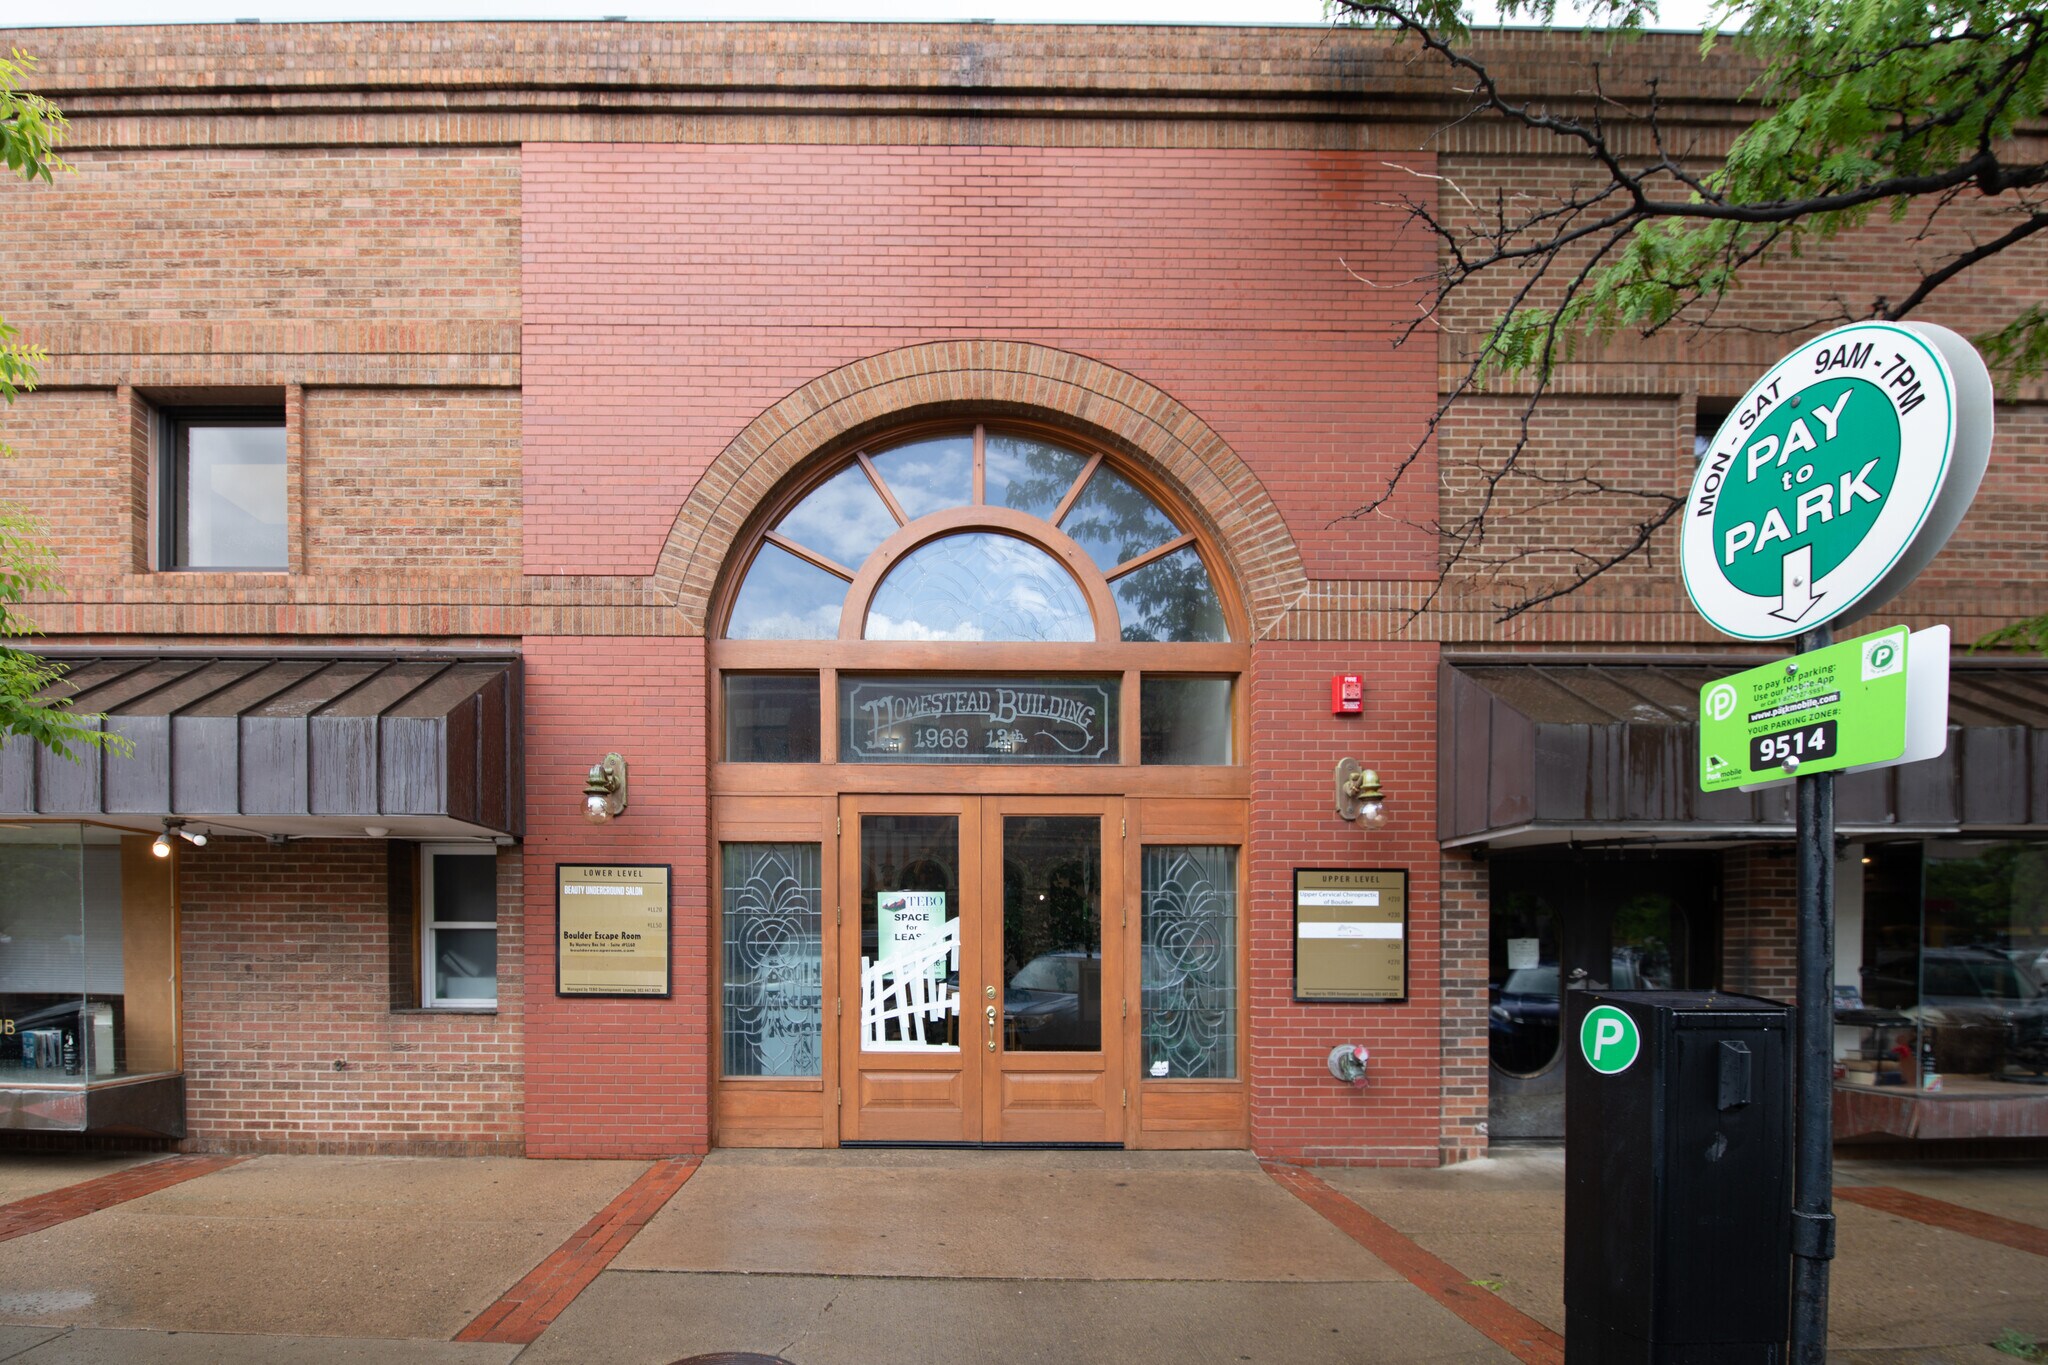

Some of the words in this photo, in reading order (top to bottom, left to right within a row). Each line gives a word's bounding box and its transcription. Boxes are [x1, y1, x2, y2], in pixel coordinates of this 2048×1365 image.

[1697, 452, 1731, 517] MON
[1739, 376, 1782, 430] SAT
[1814, 342, 1874, 375] 9AM
[1881, 353, 1927, 416] 7PM
[1747, 387, 1855, 484] PAY
[1781, 463, 1815, 492] to
[1724, 457, 1883, 567] PARK
[1753, 684, 1763, 692] To
[1765, 679, 1781, 691] pay
[1783, 674, 1796, 684] for
[1798, 664, 1837, 681] parking:
[1753, 693, 1769, 702] Use
[1770, 688, 1784, 697] our
[1786, 679, 1815, 693] Mobile
[1817, 675, 1835, 687] App
[1748, 724, 1769, 736] YOUR
[1771, 715, 1807, 730] PARKING
[1809, 708, 1842, 721] ZONE#:
[914, 728, 969, 749] 1966
[1760, 727, 1826, 762] 9514
[584, 869, 613, 877] LOWER
[617, 870, 643, 878] LEVEL
[1322, 875, 1350, 883] UPPER
[564, 885, 585, 895] BEAUTY
[585, 885, 625, 896] UNDERGROUND
[625, 886, 643, 896] SALON
[1342, 891, 1377, 899] Chiropractic
[907, 896, 943, 906] TEBO
[894, 913, 929, 921] SPACE
[563, 931, 593, 940] Boulder
[594, 931, 619, 941] Escape
[621, 931, 642, 940] Room
[894, 933, 925, 941] LEAS
[0, 1019, 15, 1035] B
